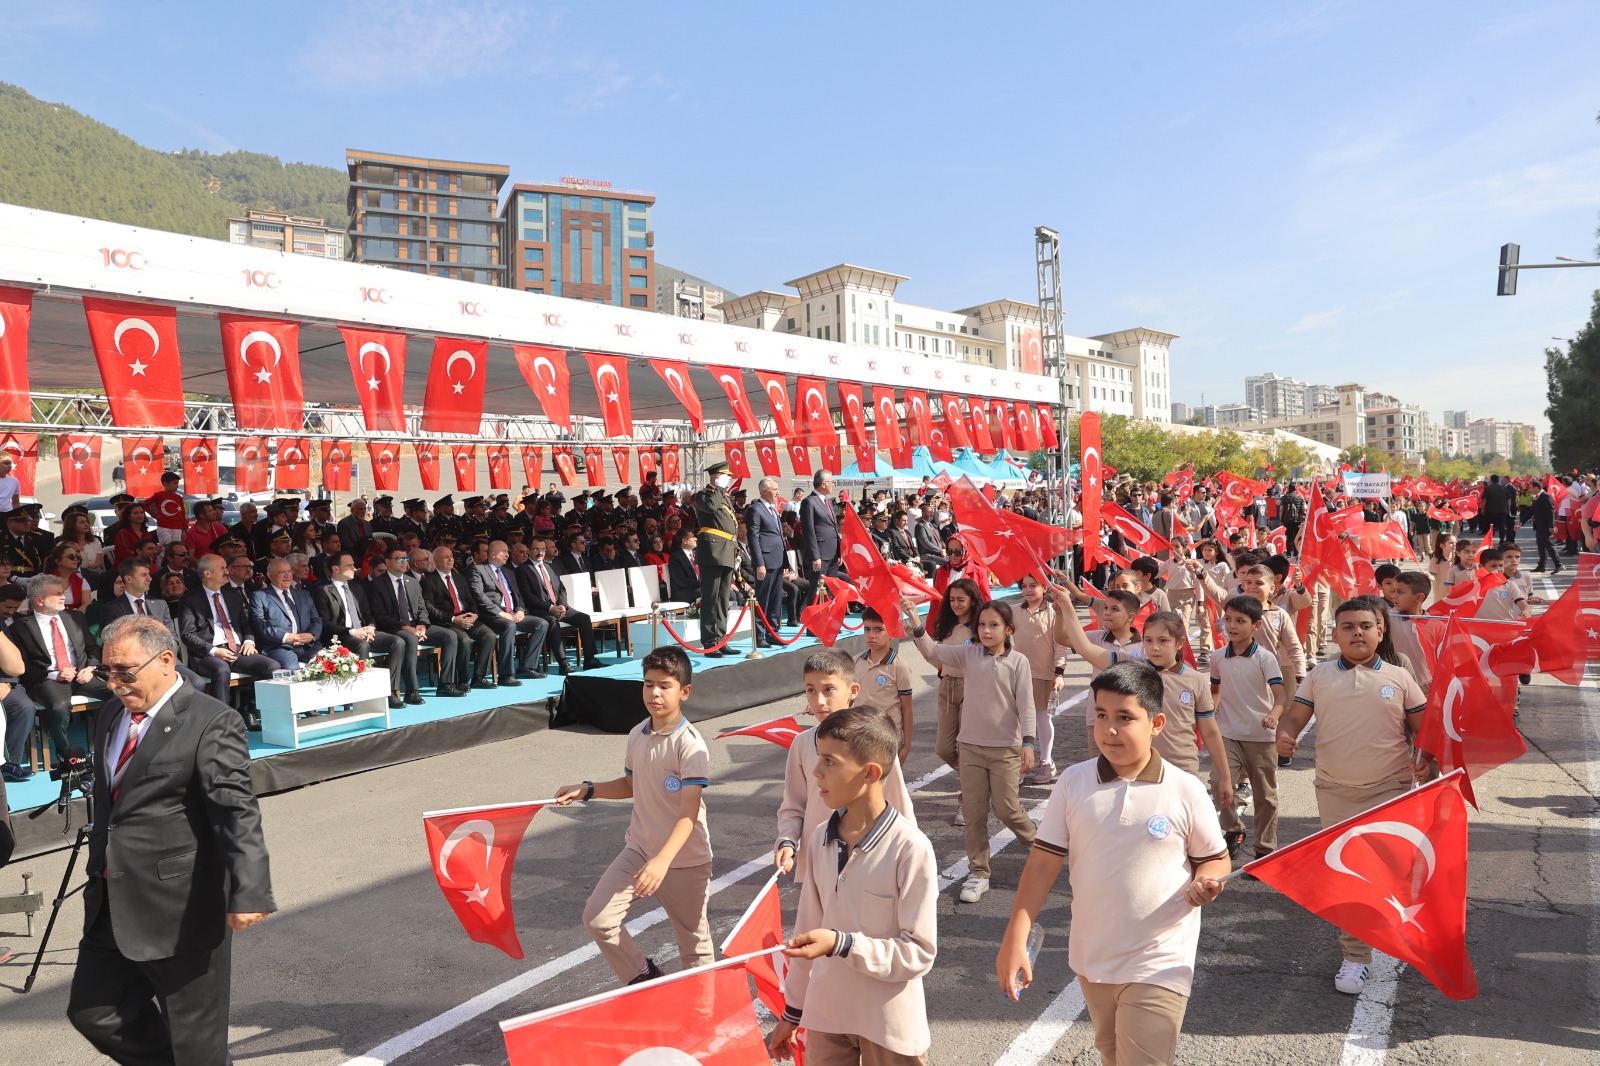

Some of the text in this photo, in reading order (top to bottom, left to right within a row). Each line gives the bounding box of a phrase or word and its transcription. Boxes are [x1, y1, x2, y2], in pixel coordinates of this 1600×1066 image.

[99, 247, 144, 271] 100
[242, 269, 278, 289] 100
[359, 286, 389, 304] 100
